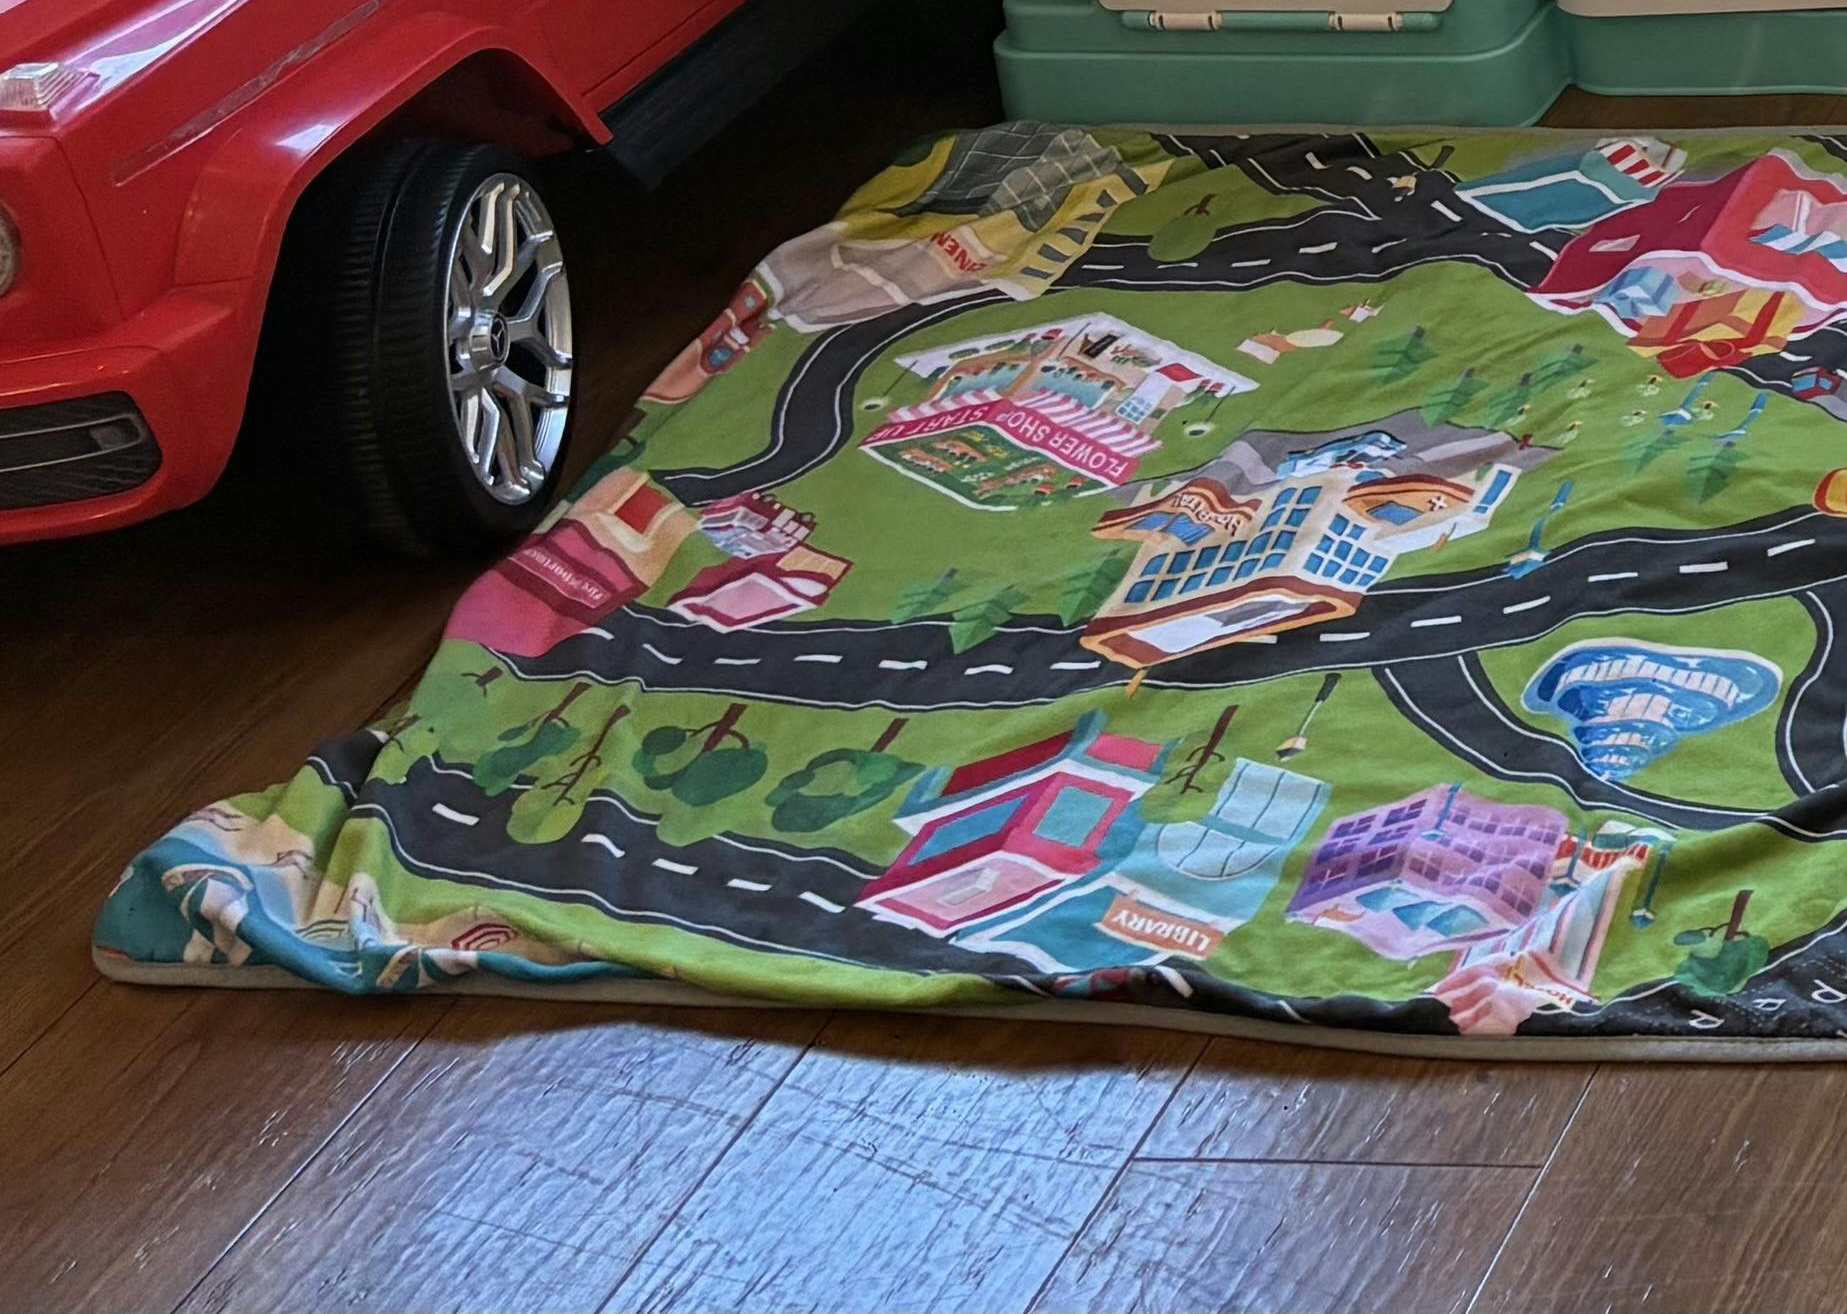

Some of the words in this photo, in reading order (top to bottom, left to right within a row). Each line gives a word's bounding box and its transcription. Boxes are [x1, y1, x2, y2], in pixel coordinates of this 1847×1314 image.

[911, 404, 988, 437] START
[995, 410, 1050, 443] SHOP
[1051, 428, 1128, 479] FLOWER
[1112, 909, 1211, 952] LIBRARY
